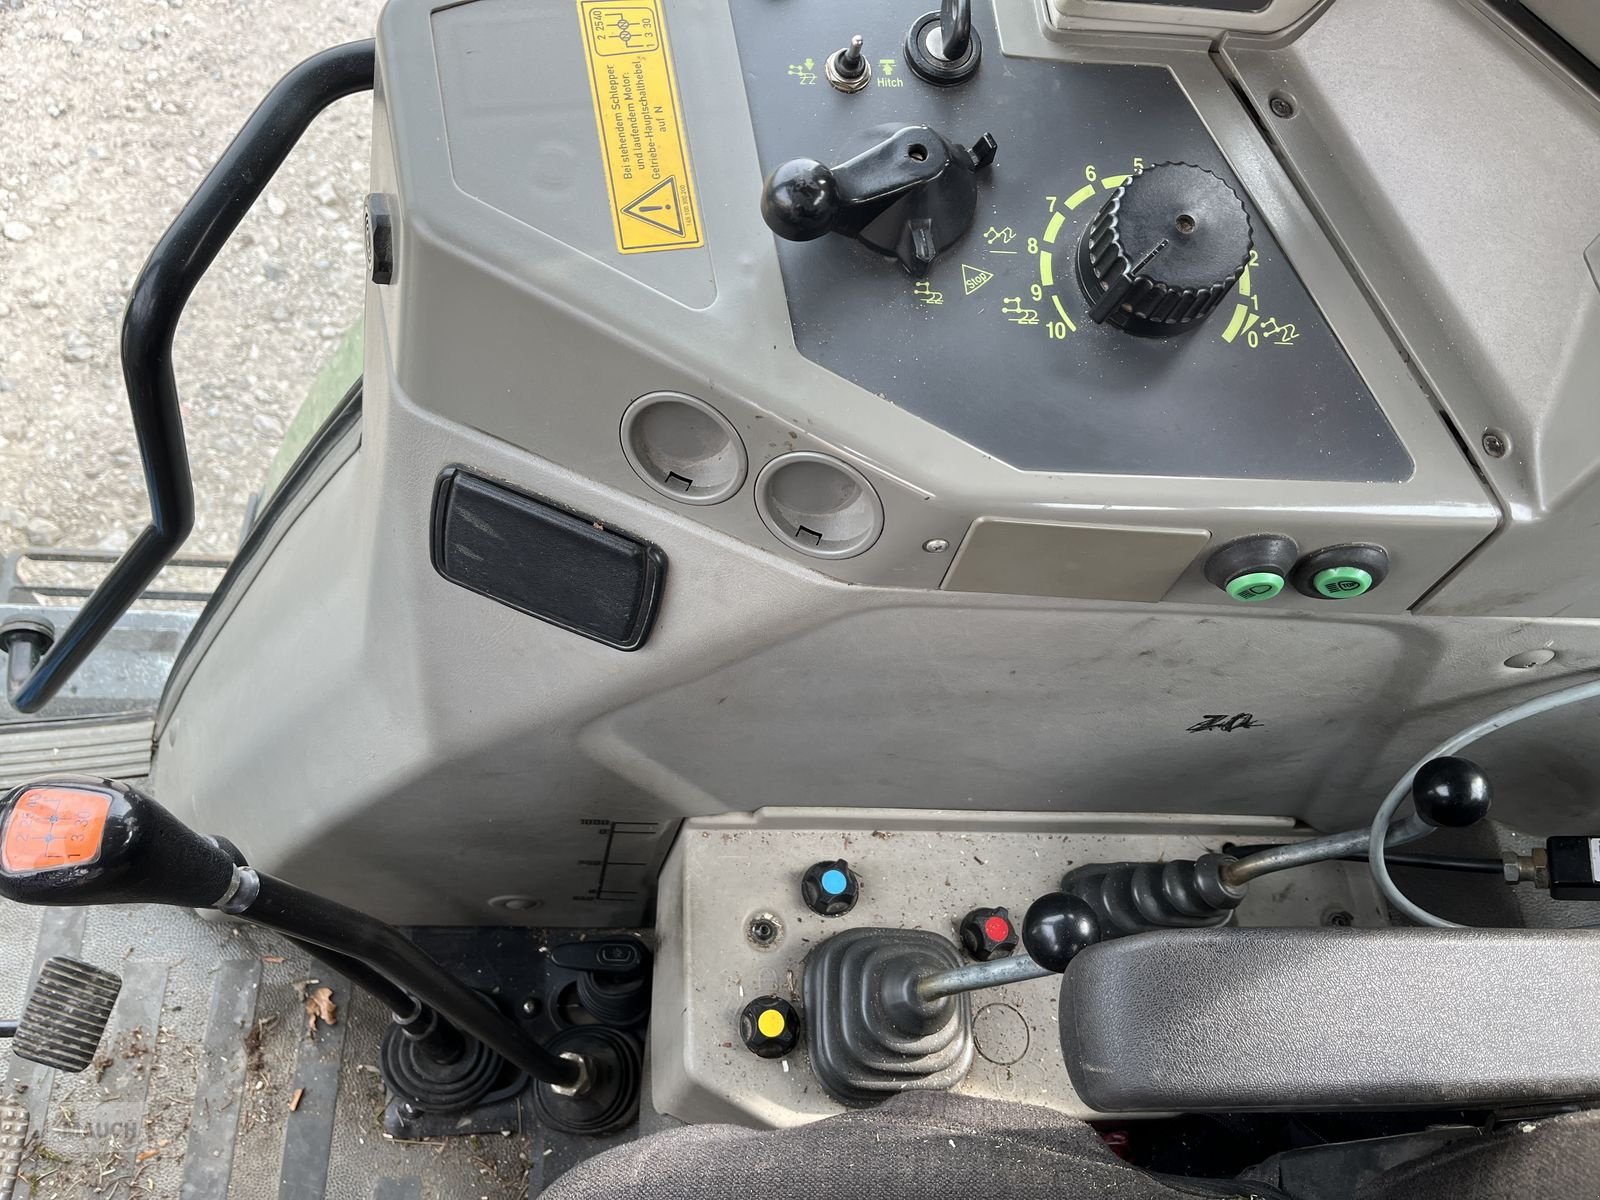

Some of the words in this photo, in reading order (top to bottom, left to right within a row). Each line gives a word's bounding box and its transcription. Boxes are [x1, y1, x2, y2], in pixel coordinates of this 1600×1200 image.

[592, 10, 602, 20] 40
[641, 18, 652, 28] 30
[594, 21, 605, 31] 25
[606, 64, 621, 110] Schlepper
[877, 77, 904, 88] Hitch
[627, 102, 642, 151] laufendem
[655, 118, 667, 133] auf
[615, 112, 630, 163] stehendem
[634, 153, 645, 170] und
[1133, 158, 1144, 171] 5
[620, 165, 633, 180] Bei
[1085, 165, 1097, 181] 6
[1046, 196, 1057, 213] 7
[1027, 237, 1039, 254] 8
[1249, 249, 1259, 267] 2
[966, 272, 987, 289] Stop
[1030, 284, 1042, 301] 9
[1250, 294, 1259, 311] 1
[1046, 321, 1066, 340] 10
[1247, 330, 1259, 348] 0
